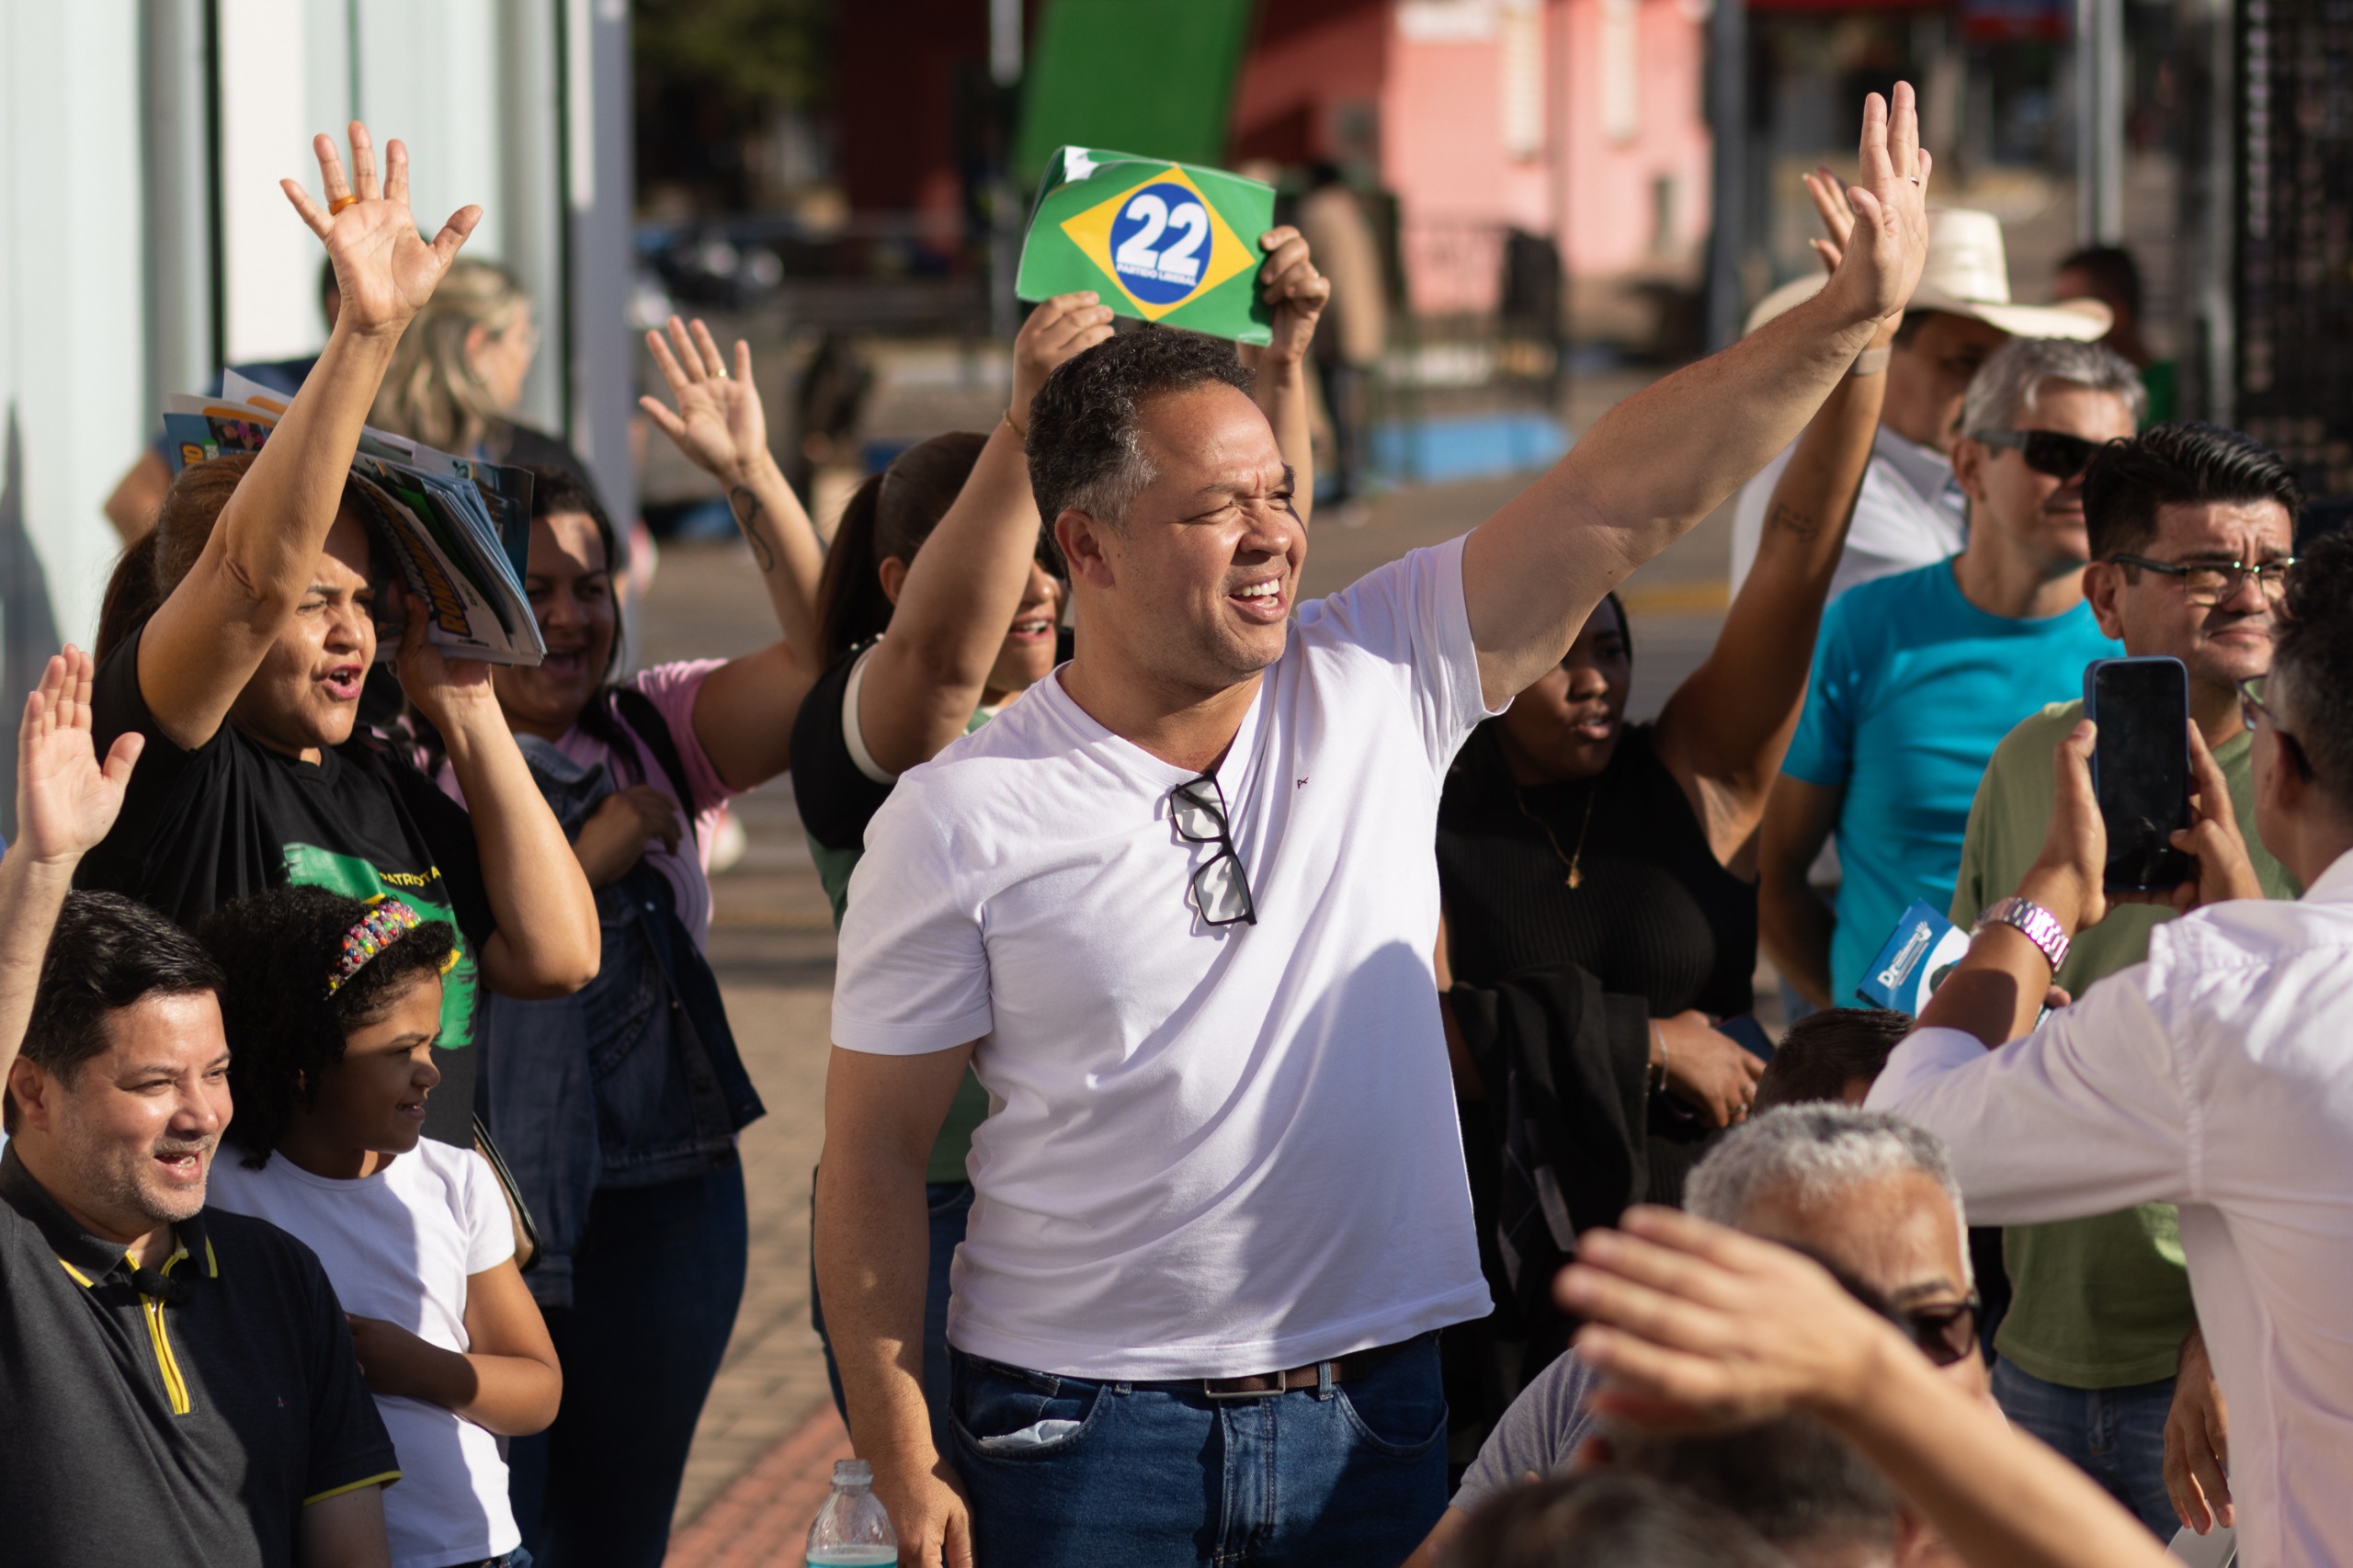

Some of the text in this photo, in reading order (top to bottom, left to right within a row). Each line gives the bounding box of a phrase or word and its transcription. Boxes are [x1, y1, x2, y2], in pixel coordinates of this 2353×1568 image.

[1116, 194, 1208, 277] 22
[1116, 262, 1197, 287] PARTIDO LIBERAL
